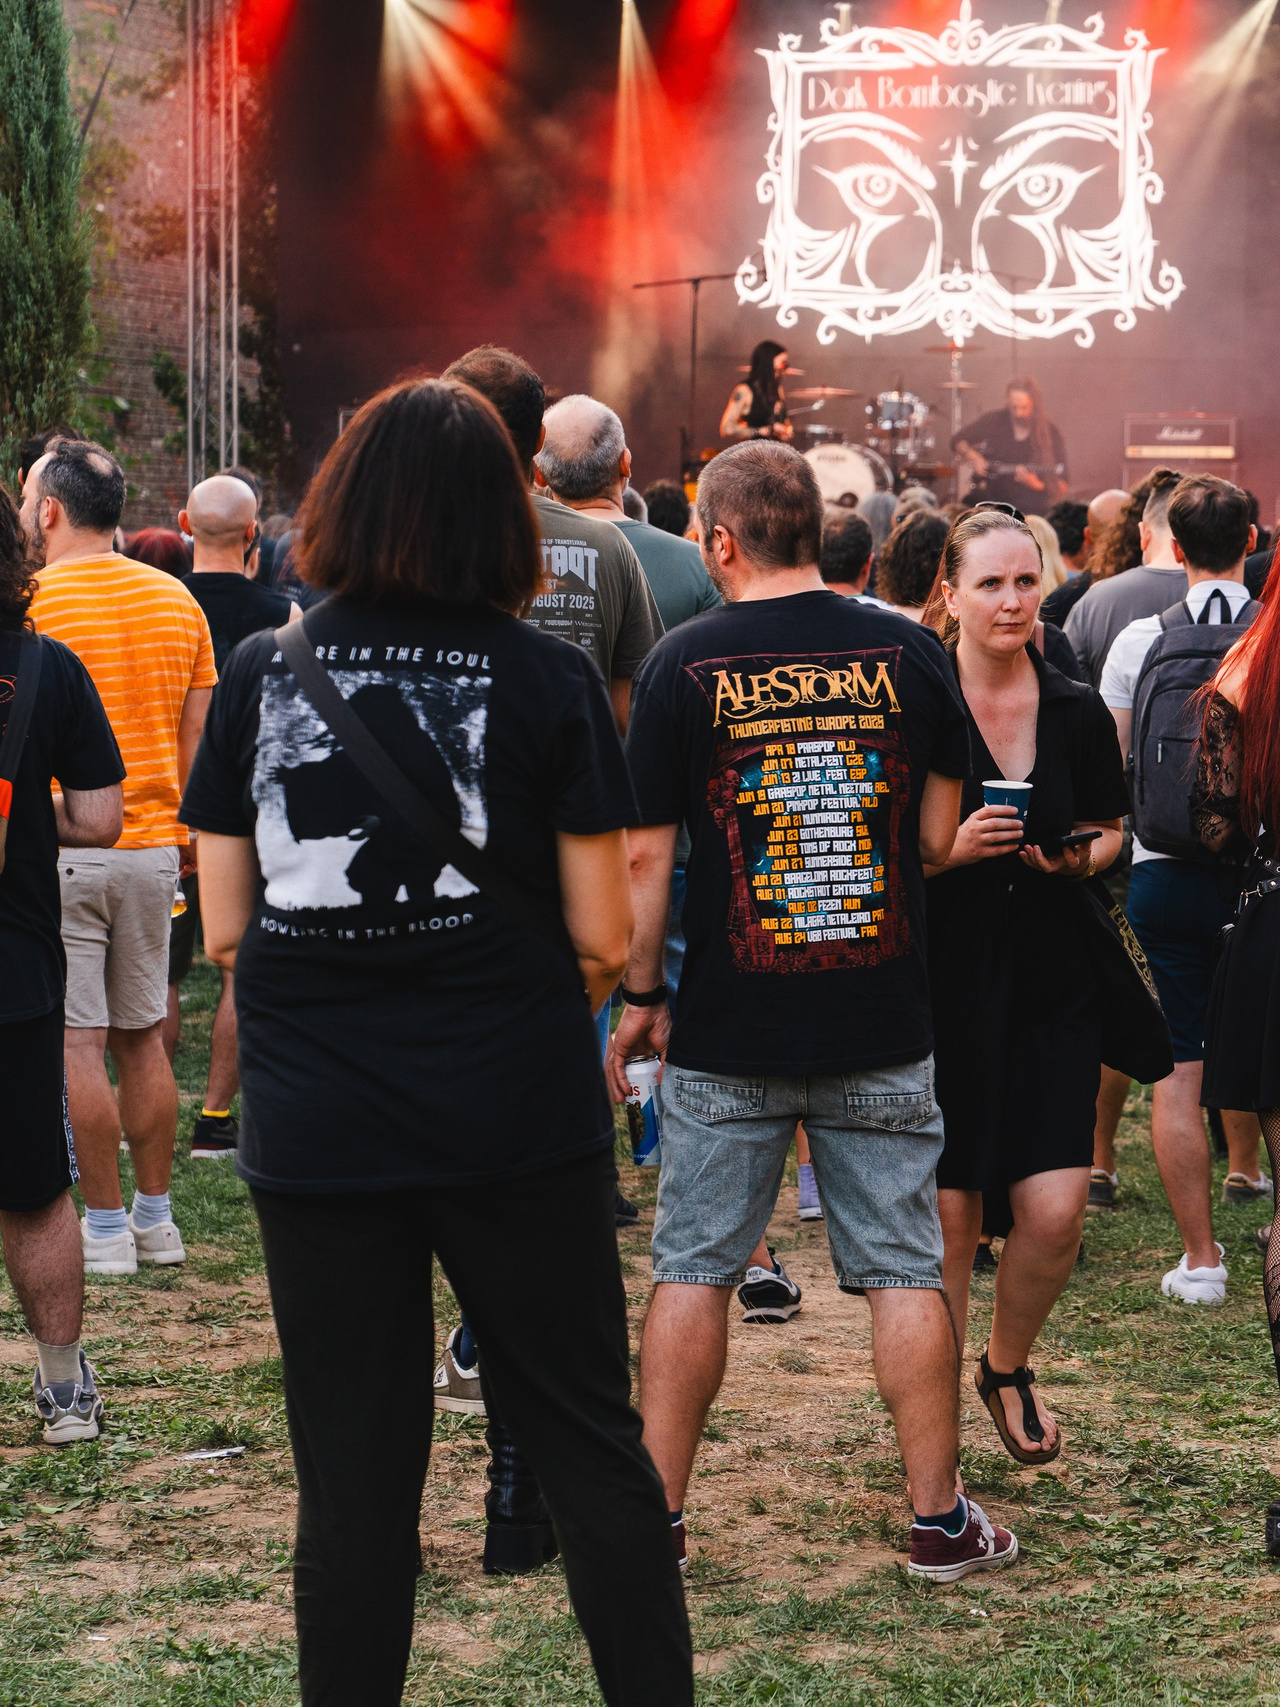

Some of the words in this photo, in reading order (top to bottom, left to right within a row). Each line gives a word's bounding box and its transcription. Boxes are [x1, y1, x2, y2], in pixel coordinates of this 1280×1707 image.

[808, 76, 868, 111] Dark
[878, 75, 1016, 118] Bombastic
[569, 594, 595, 610] 2025
[271, 651, 283, 663] A
[314, 645, 339, 662] RE
[349, 646, 373, 661] IN
[385, 646, 425, 662] THE
[435, 649, 491, 670] SOUL
[712, 662, 902, 727] ALESTORM
[728, 716, 812, 739] THUNDERFISTING
[815, 715, 856, 731] EUROPE
[858, 714, 884, 730] 2025
[765, 744, 784, 756] APR
[785, 743, 796, 755] 18
[797, 741, 835, 754] PAASPOP
[837, 740, 856, 752] NLD
[761, 758, 779, 772] JUN
[780, 758, 793, 770] 07
[794, 755, 844, 769] METALFEST
[845, 754, 864, 766] CZE
[761, 773, 778, 786] JUN
[780, 772, 791, 784] 13
[802, 770, 821, 782] LIVE
[825, 768, 848, 780] FEST
[849, 768, 867, 780] ESP
[737, 790, 756, 804] JUN
[757, 789, 766, 801] 19
[767, 785, 807, 799] GRASPOP
[808, 783, 837, 796] METAL
[838, 782, 873, 794] MEETING
[874, 782, 890, 793] BEL
[753, 803, 770, 816] JUN
[771, 801, 784, 814] 20
[786, 799, 819, 812] PINKPOP
[820, 796, 860, 809] FESTIVAL
[861, 796, 878, 808] NLD
[773, 815, 792, 828] JUN
[792, 814, 802, 826] 21
[802, 811, 849, 825] NUMMIROCK
[767, 830, 785, 842] JUN
[786, 829, 799, 841] 23
[799, 826, 853, 840] GOTHENBURG
[766, 844, 784, 857] JUN
[785, 843, 798, 855] 25
[799, 841, 818, 854] TONS
[819, 841, 831, 853] OF
[832, 840, 857, 852] ROCK
[771, 858, 789, 871] JUN
[791, 857, 803, 869] 27
[804, 855, 853, 868] SUMMERSIDE
[854, 853, 871, 866] CHE
[752, 874, 768, 887] JUN
[769, 873, 782, 885] 29
[784, 870, 828, 885] BARCELONA
[829, 867, 874, 881] ROCKFEST
[756, 888, 773, 900] AUG
[775, 888, 786, 900] 01
[787, 885, 831, 899] ROCKSTADT
[832, 882, 872, 896] EXTREME
[788, 902, 805, 914] AUG
[807, 901, 817, 912] 02
[818, 899, 842, 911] FEZEN
[843, 898, 861, 910] HUN
[260, 915, 330, 938] HOWLING
[337, 929, 356, 939] IN
[365, 926, 398, 939] THE
[408, 913, 474, 933] BLOOD
[761, 918, 779, 930] AUG
[780, 917, 793, 929] 22
[826, 912, 871, 926] METALEIRO
[871, 908, 884, 922] PRT
[774, 932, 792, 945] AUG
[794, 931, 806, 943] 24
[822, 927, 860, 941] FESTIVAL
[860, 925, 878, 938] FRA
